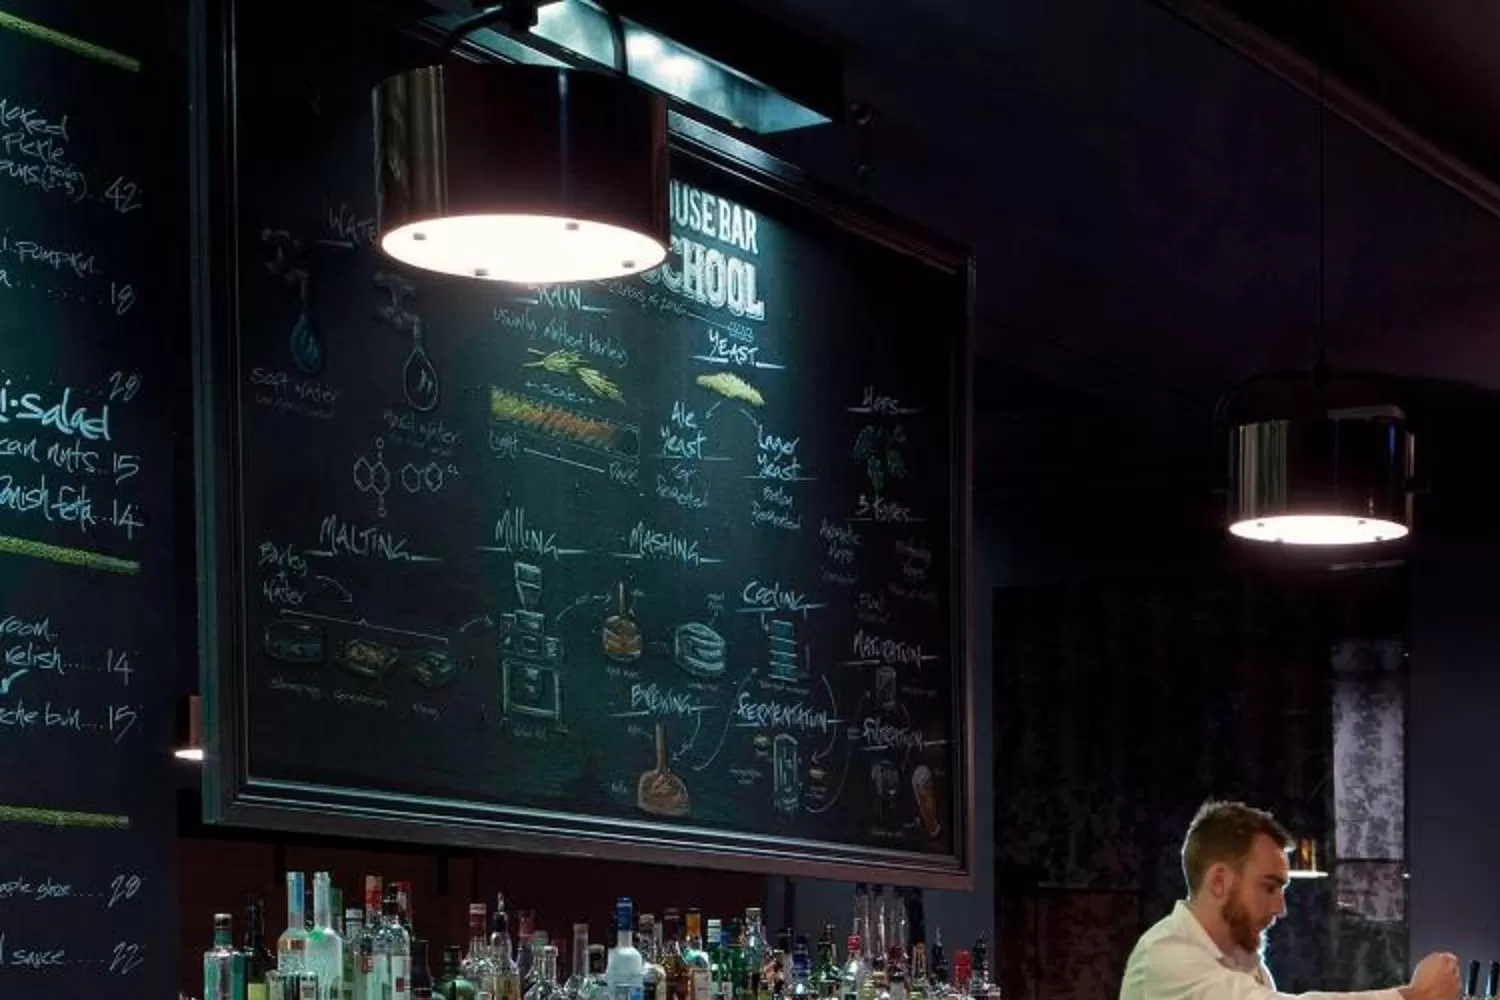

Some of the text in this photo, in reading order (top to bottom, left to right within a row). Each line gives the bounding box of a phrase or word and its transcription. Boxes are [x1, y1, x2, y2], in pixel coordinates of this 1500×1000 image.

[104, 175, 143, 214] 42
[718, 197, 758, 255] BAR
[112, 451, 141, 486] 15
[319, 512, 412, 562] MALTING
[629, 520, 700, 568] MASHING
[106, 647, 136, 688] 14
